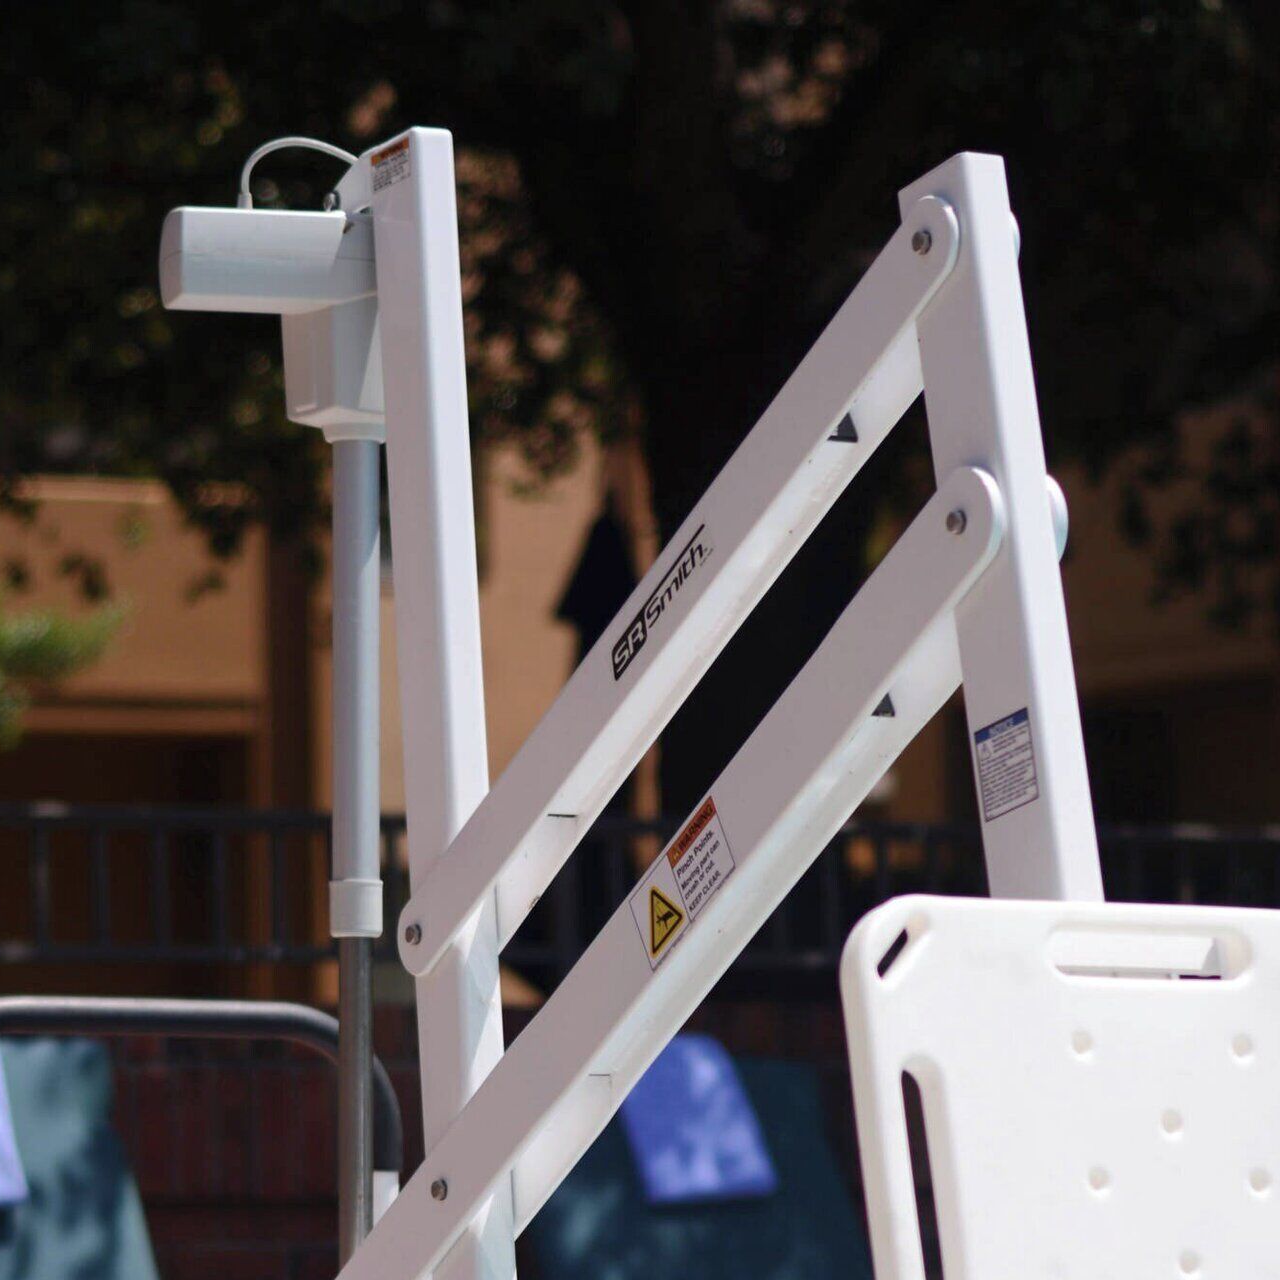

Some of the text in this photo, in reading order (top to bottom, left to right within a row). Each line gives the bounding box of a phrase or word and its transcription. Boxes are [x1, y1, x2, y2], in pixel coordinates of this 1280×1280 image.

[612, 542, 705, 680] SR Smith
[678, 803, 714, 852] WARNING
[676, 854, 695, 879] Pinch
[681, 840, 720, 890] Moving part can
[688, 892, 703, 912] KEEP
